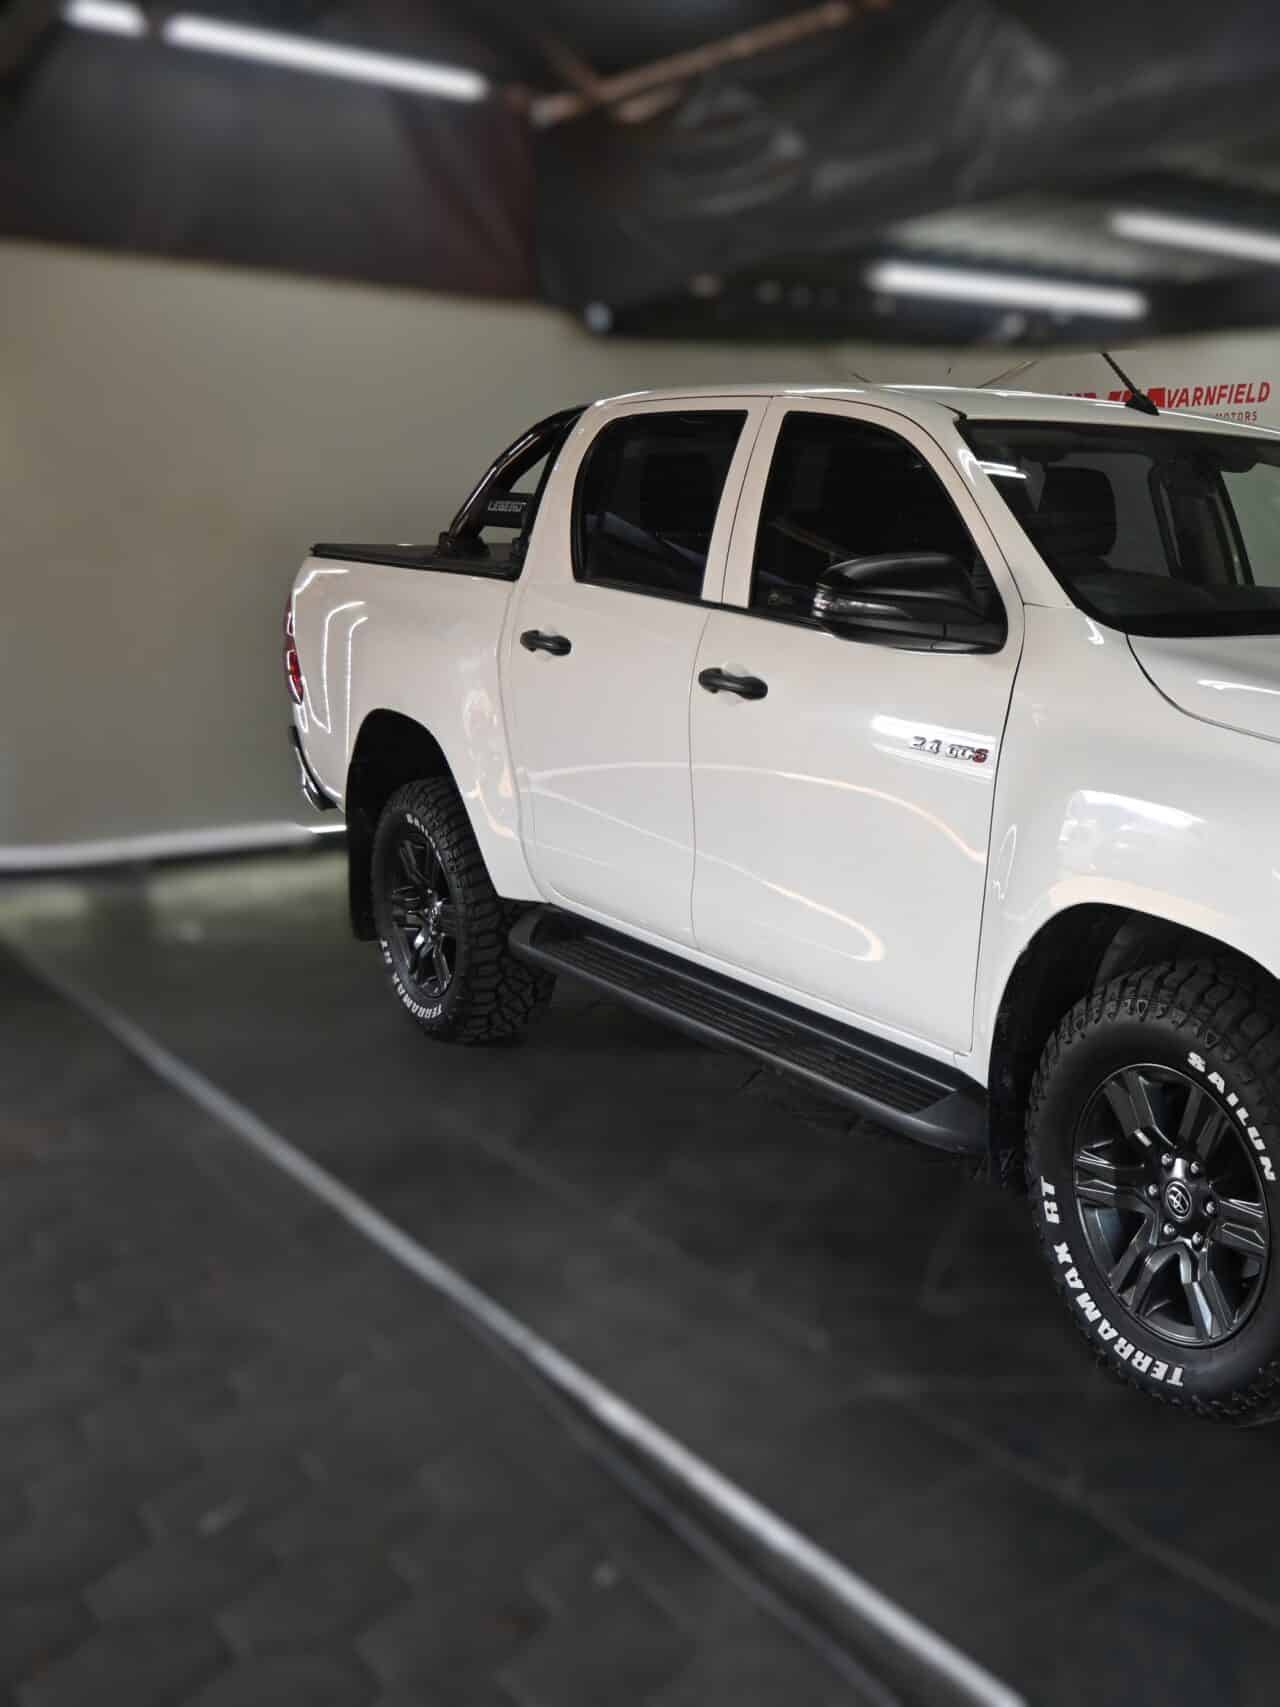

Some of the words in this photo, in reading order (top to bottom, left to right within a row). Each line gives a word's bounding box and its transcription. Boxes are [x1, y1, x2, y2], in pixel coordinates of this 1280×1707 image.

[1167, 381, 1271, 409] VARNFIELD
[1187, 1051, 1276, 1181] SAILUN
[1053, 1241, 1185, 1388] TERRAMAX
